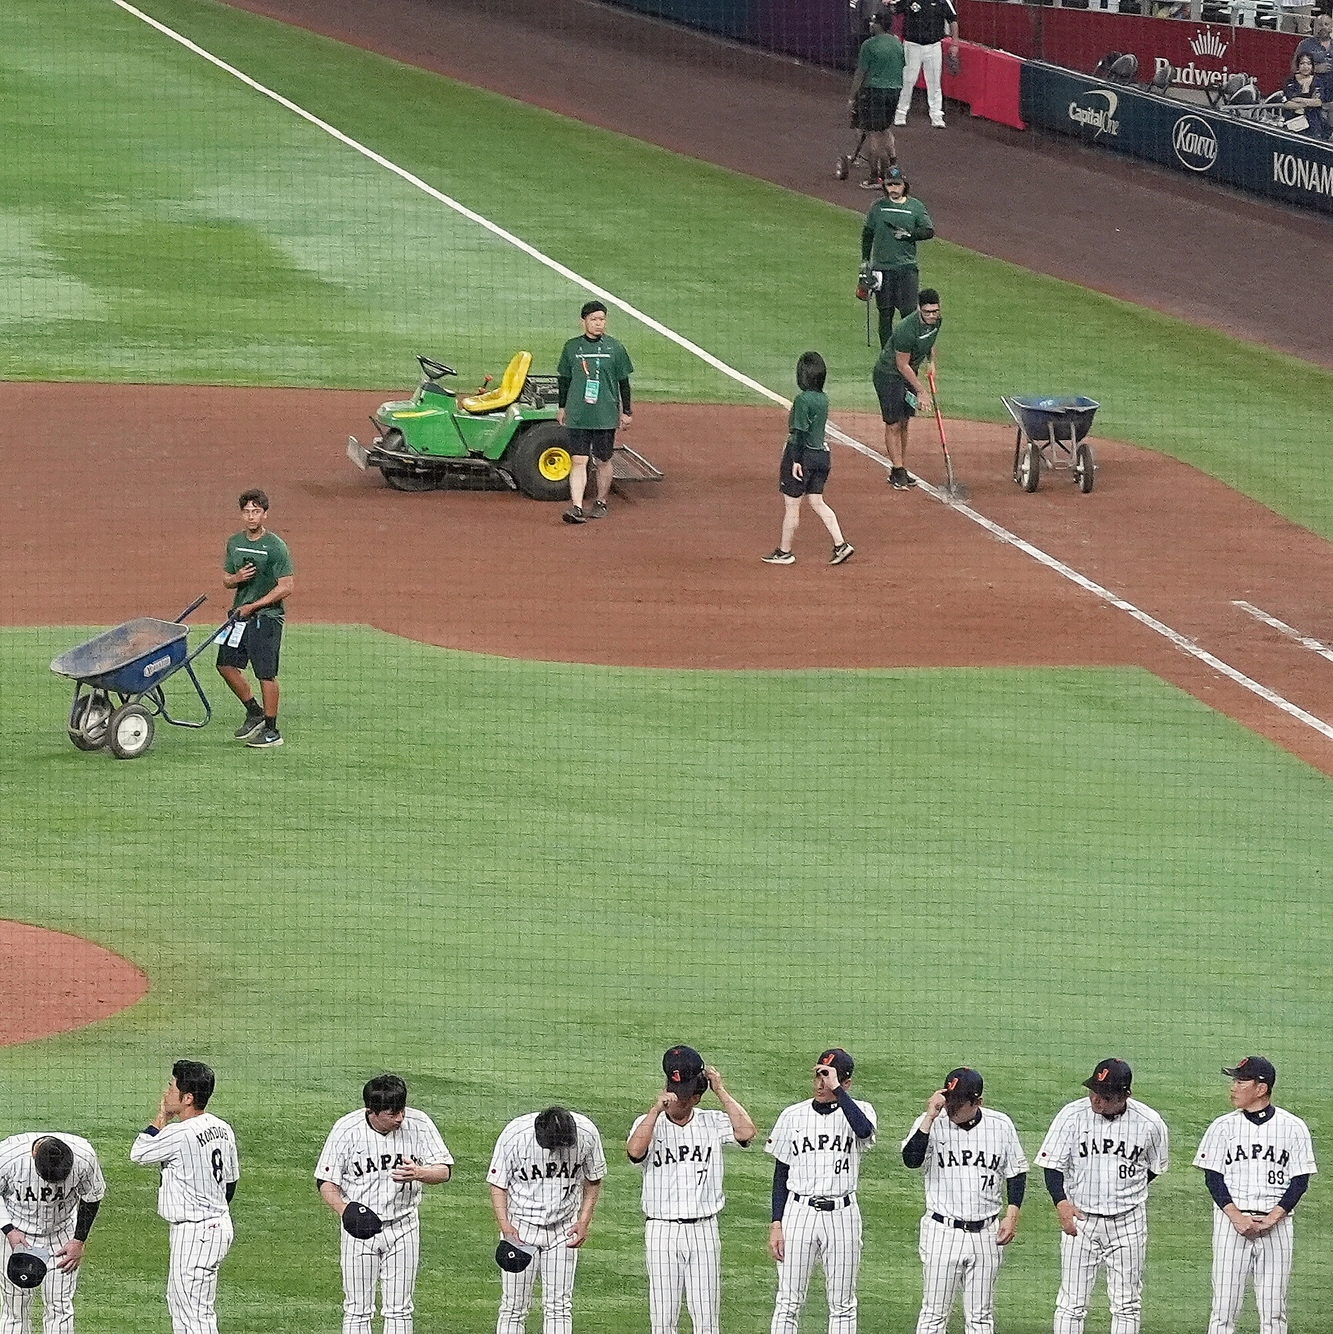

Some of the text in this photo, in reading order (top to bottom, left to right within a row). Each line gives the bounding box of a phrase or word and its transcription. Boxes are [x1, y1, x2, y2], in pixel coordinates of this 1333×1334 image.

[1154, 57, 1258, 88] udweir
[1273, 152, 1333, 197] KONAM
[792, 1134, 853, 1156] JAPAN
[1079, 1138, 1144, 1162] JAPAN
[1225, 1143, 1290, 1167] JAPAN
[211, 1148, 224, 1185] 8
[834, 1158, 849, 1175] 84
[938, 1150, 1001, 1171] JAPAN
[981, 1175, 994, 1191] 74
[1267, 1170, 1284, 1185] 89
[16, 1186, 66, 1202] APA
